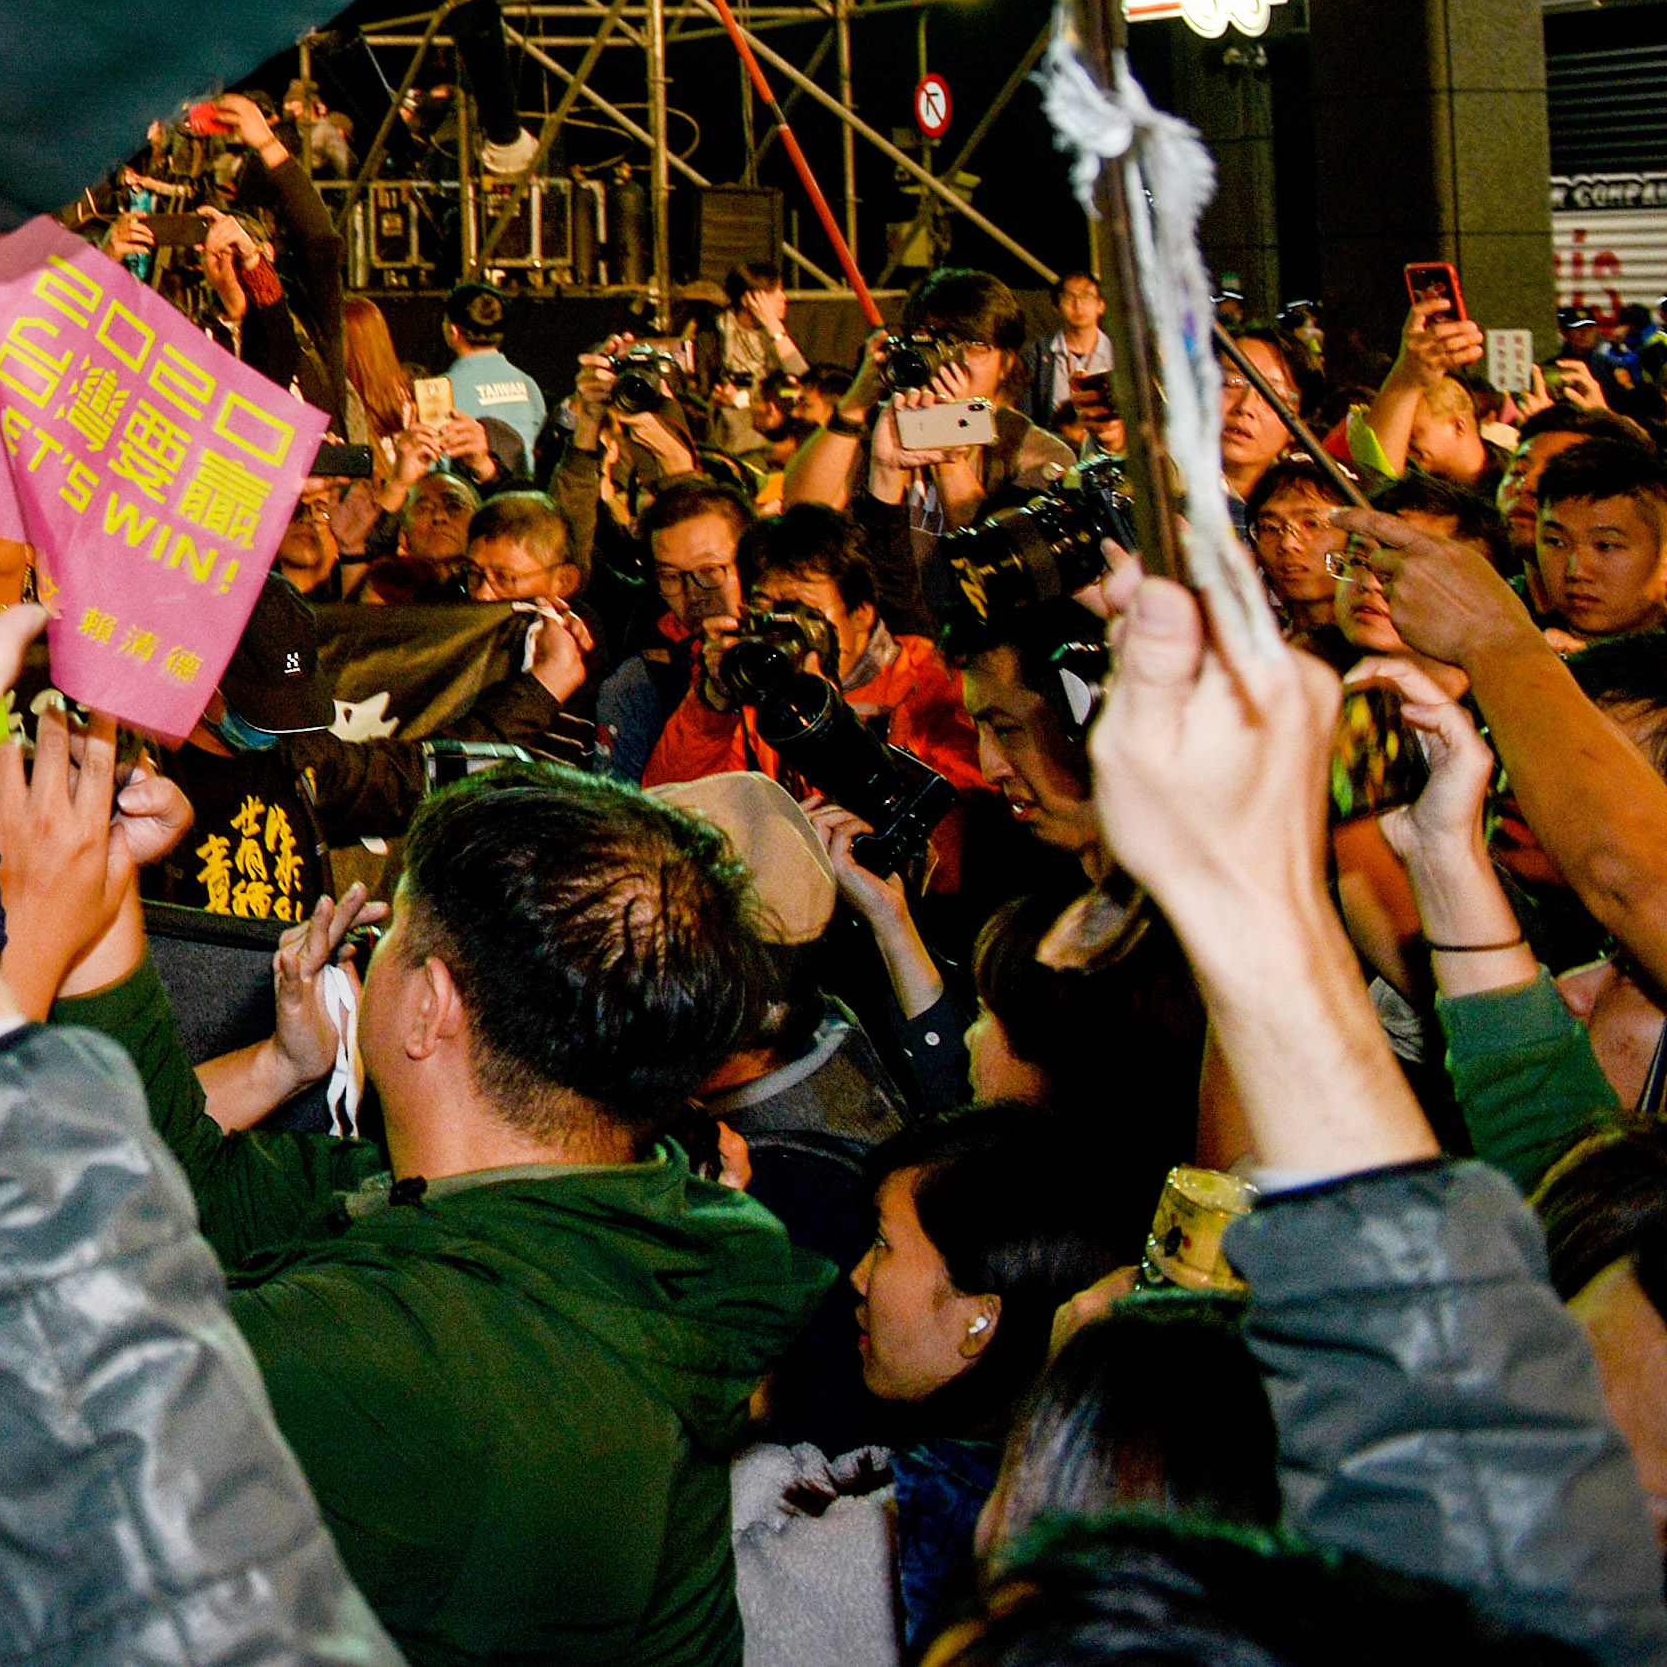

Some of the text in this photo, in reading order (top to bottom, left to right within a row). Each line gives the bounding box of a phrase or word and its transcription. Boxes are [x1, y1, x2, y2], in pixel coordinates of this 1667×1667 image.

[32, 255, 295, 467] 2020
[102, 491, 241, 594] WIN!
[77, 606, 205, 683] 賴清德
